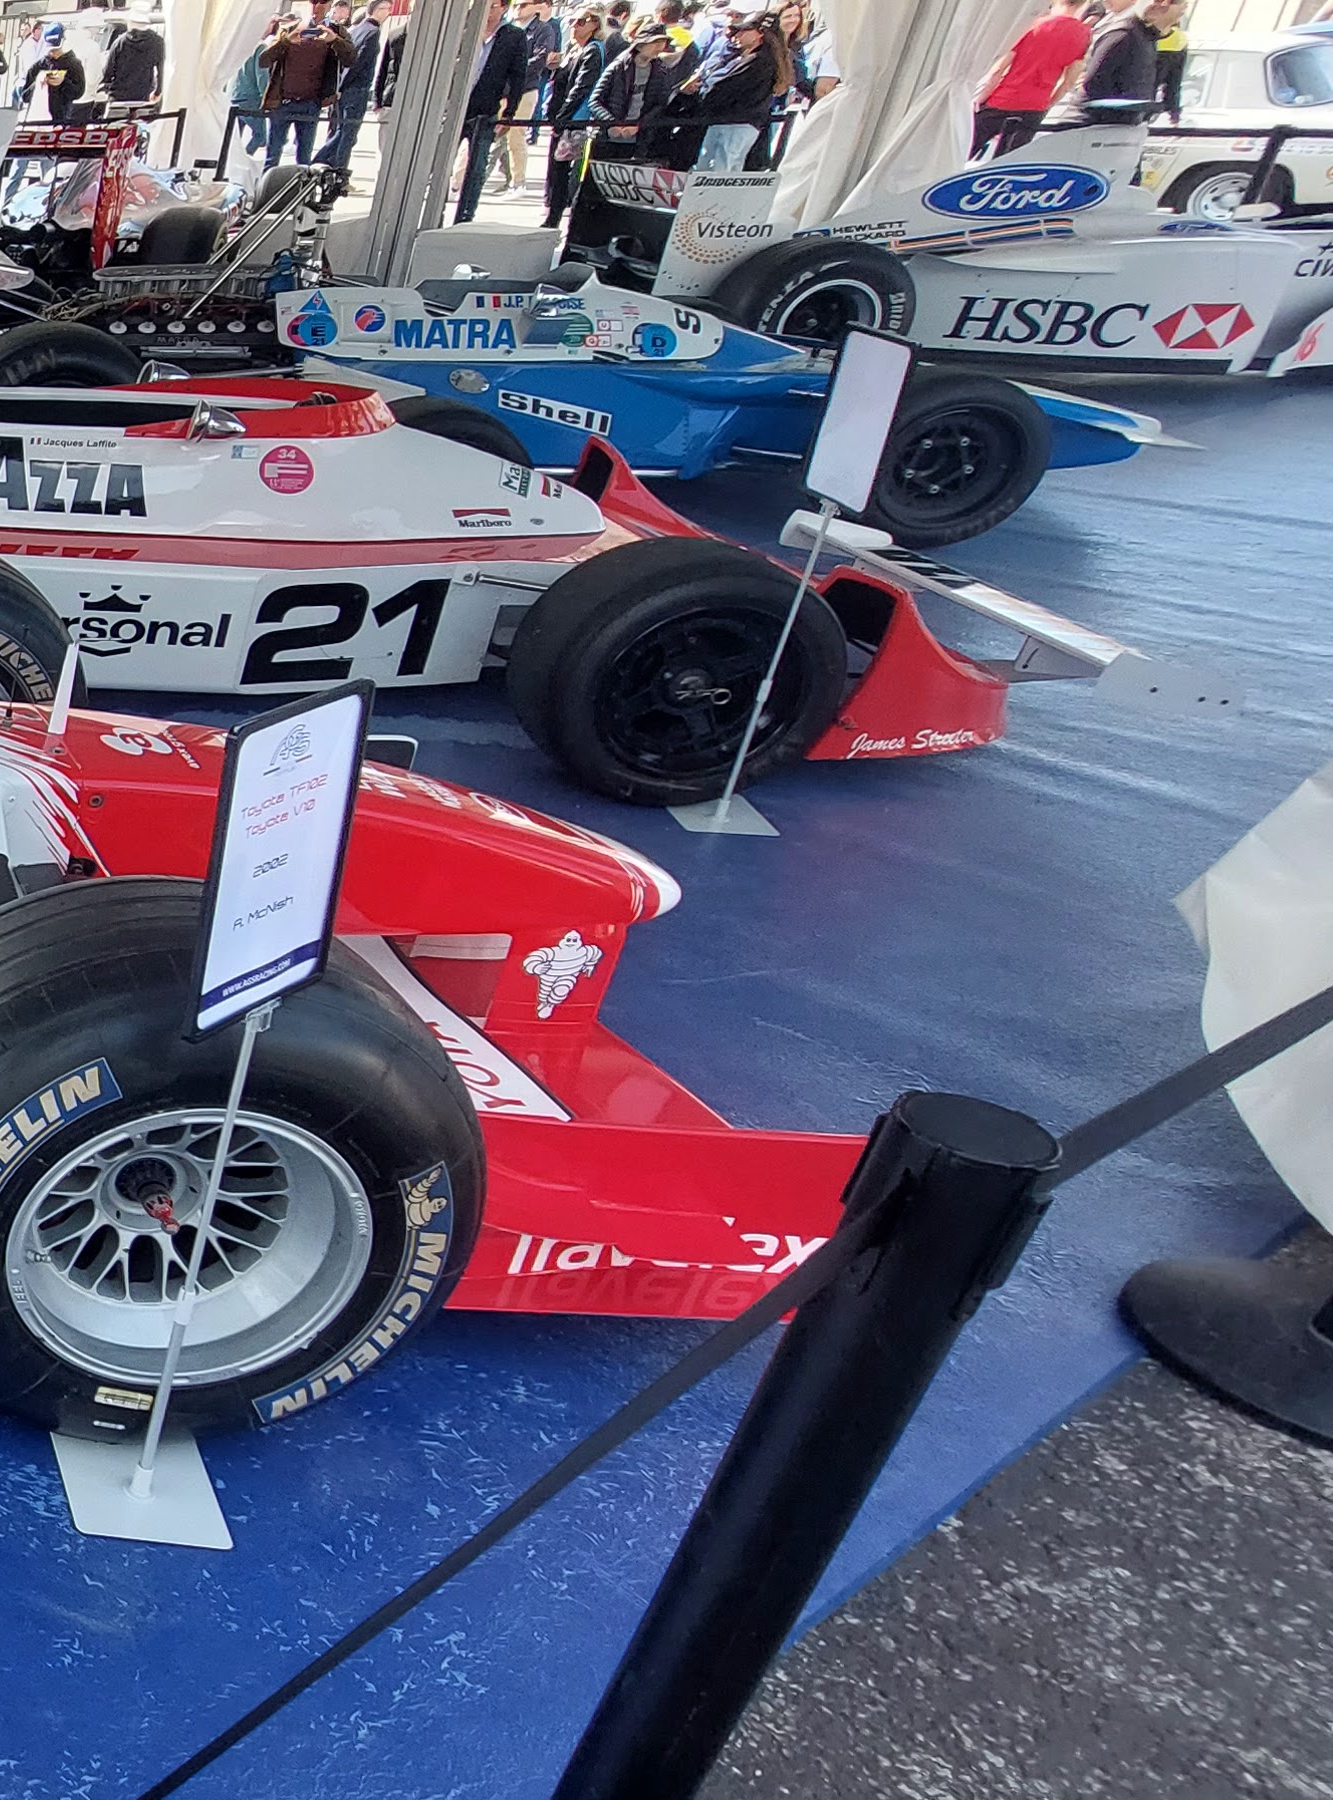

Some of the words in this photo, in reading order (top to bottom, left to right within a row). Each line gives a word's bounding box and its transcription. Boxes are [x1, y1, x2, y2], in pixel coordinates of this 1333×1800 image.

[691, 176, 776, 188] BRIDGESTONE
[958, 172, 1073, 211] Ford
[697, 222, 774, 239] Visteon
[833, 220, 908, 235] HEWLETT
[836, 229, 906, 243] ACKARD
[393, 317, 518, 350] MATRA
[942, 295, 1149, 348] HSBC
[500, 391, 610, 434] Shell
[43, 438, 84, 448] Jacques
[277, 448, 297, 460] 34
[458, 519, 512, 528] Marlboro
[60, 612, 232, 650] rsonal
[238, 578, 452, 686] 21
[846, 732, 906, 760] James
[241, 793, 285, 820] Toyota
[245, 812, 289, 839] Toyota
[269, 1231, 449, 1420] MICHELIN
